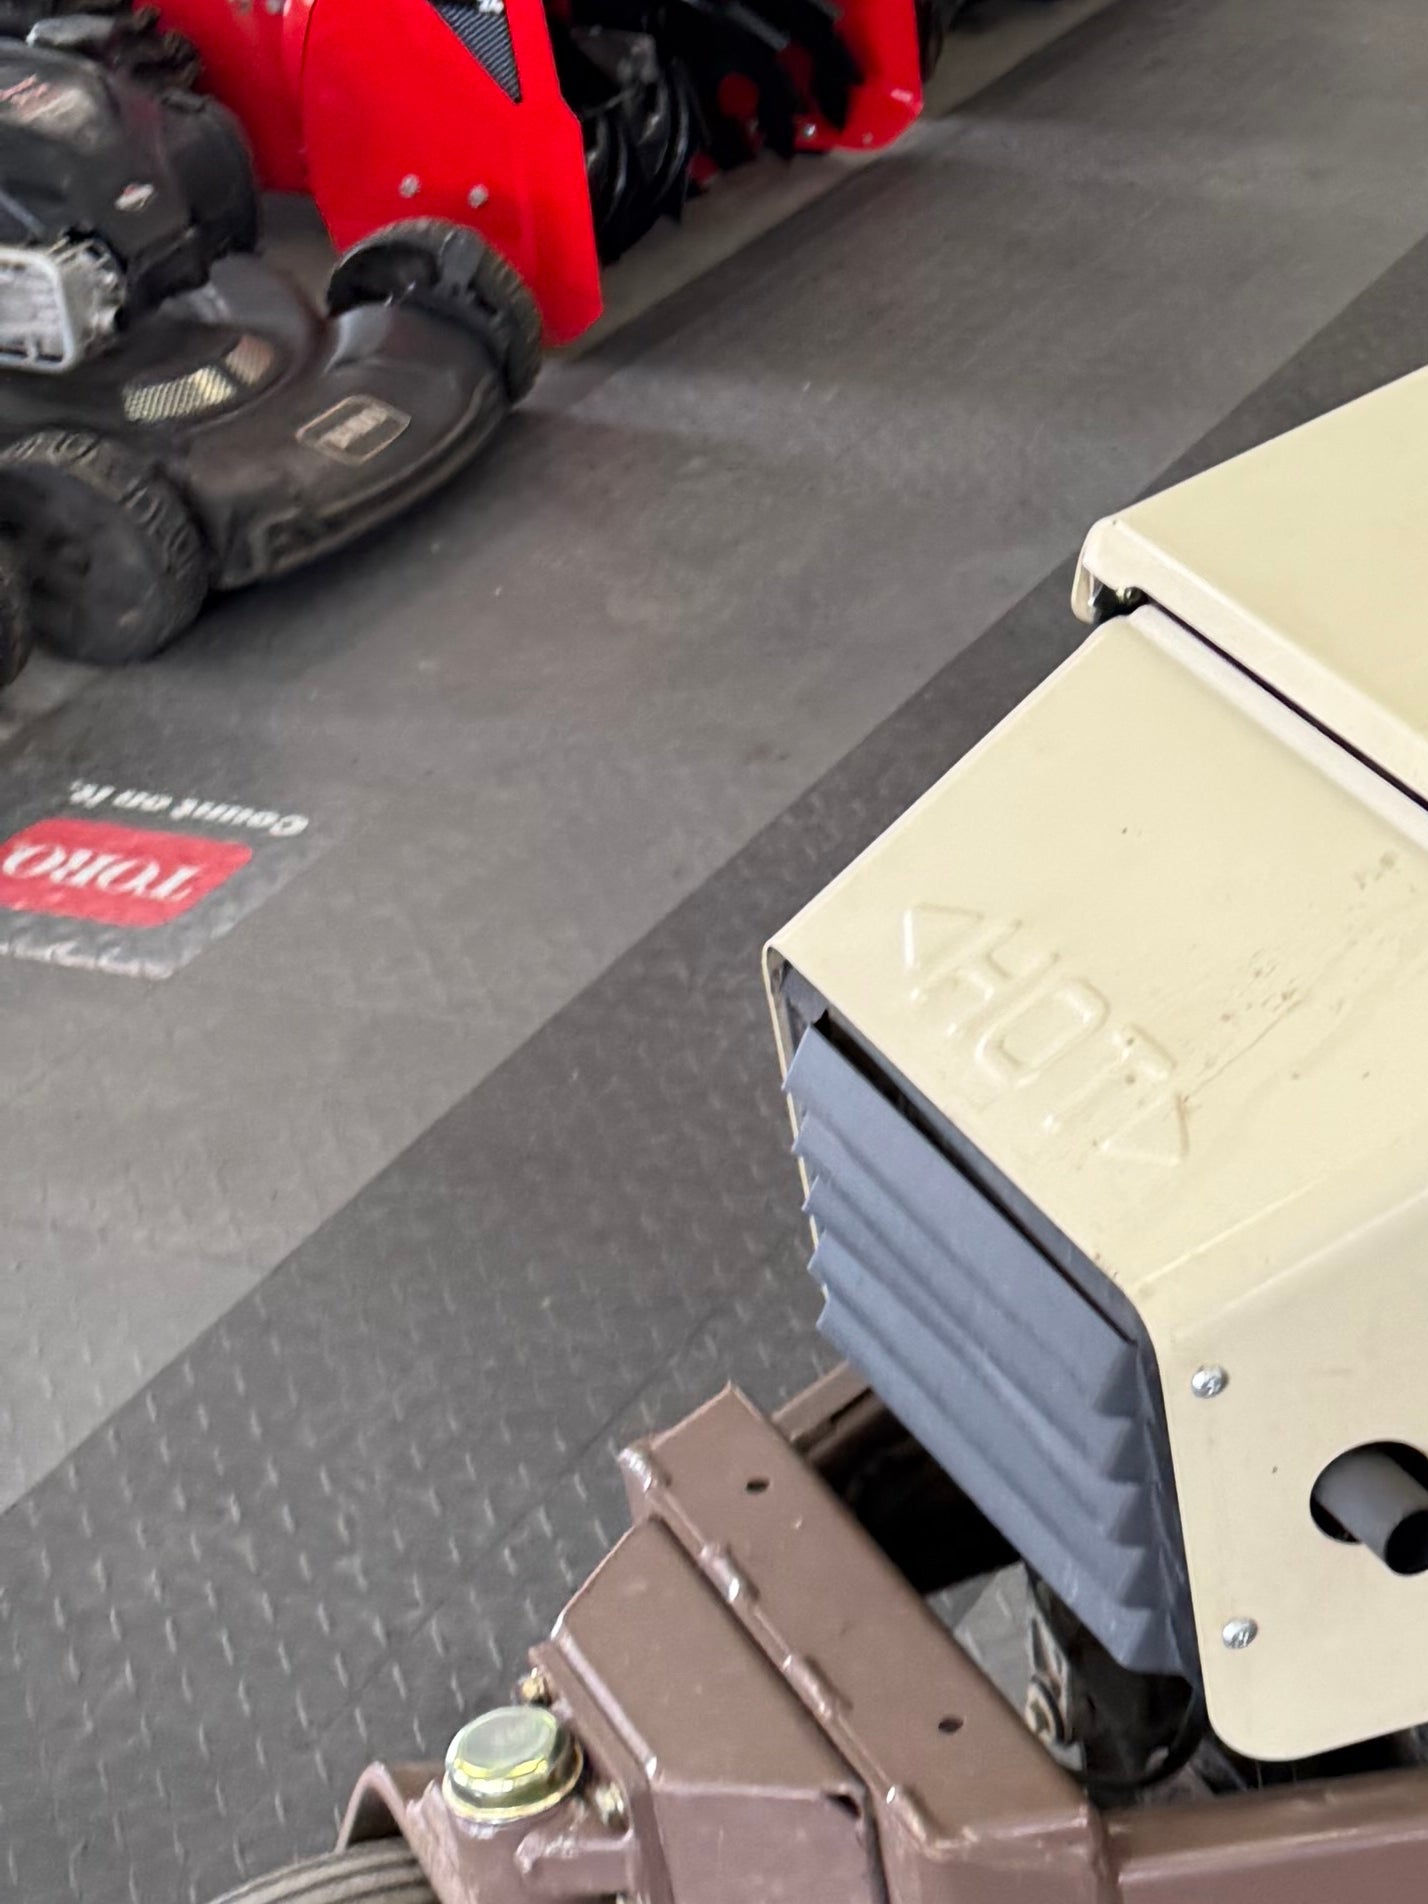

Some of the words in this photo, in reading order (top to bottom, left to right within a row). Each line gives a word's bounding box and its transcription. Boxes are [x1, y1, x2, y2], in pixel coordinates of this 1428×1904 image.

[113, 790, 174, 812] on
[169, 798, 309, 836] Count
[2, 843, 201, 901] TORO
